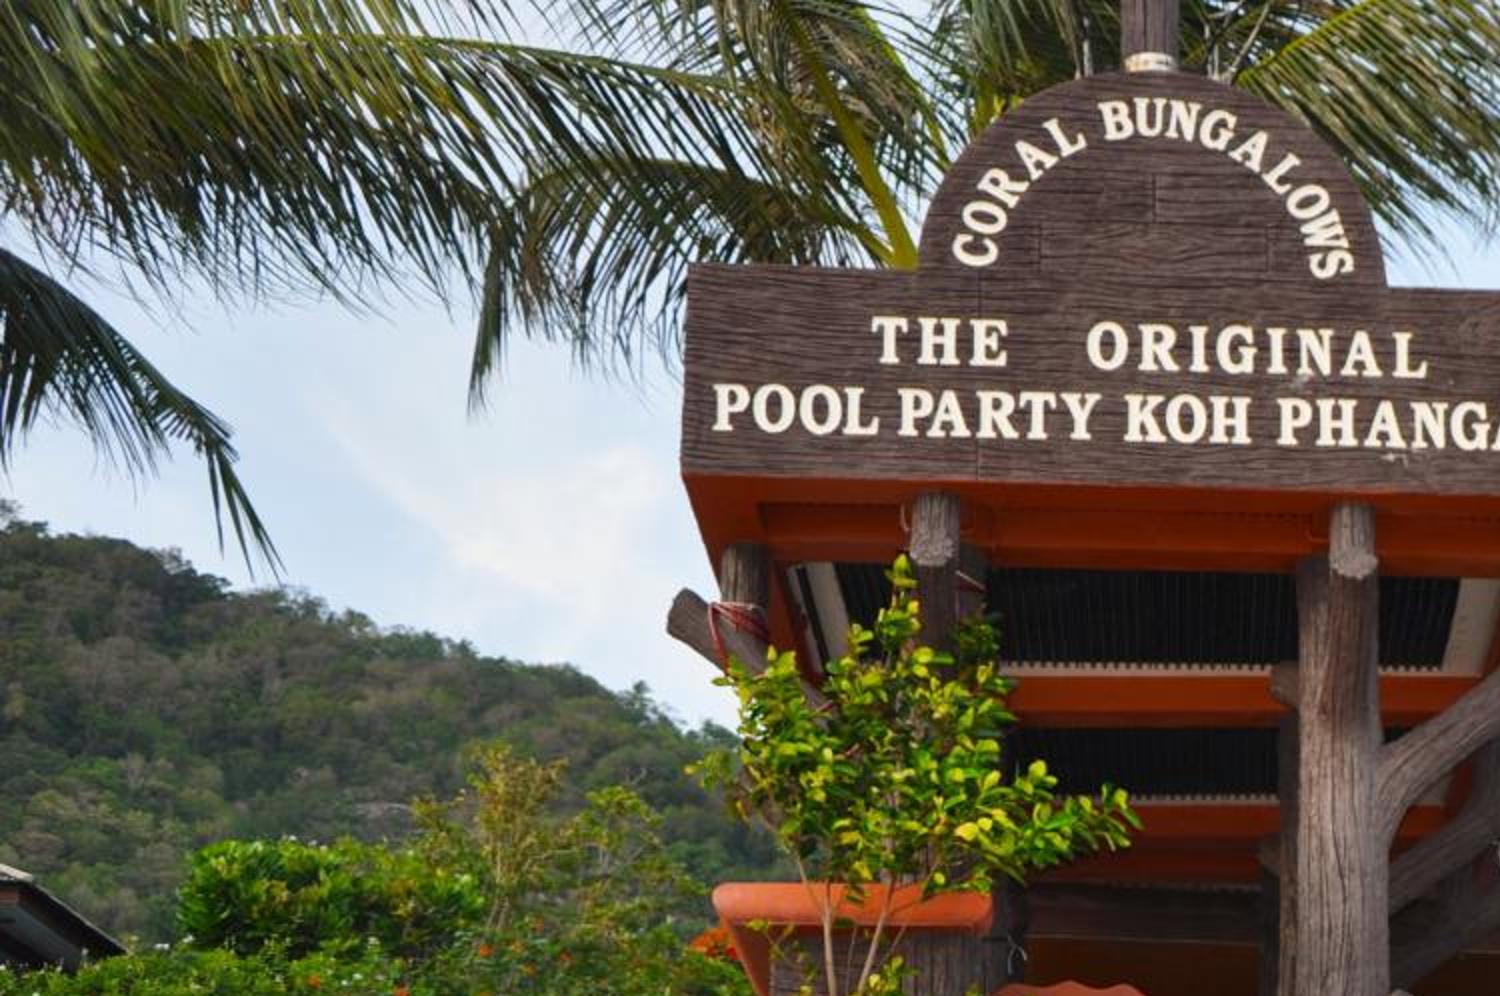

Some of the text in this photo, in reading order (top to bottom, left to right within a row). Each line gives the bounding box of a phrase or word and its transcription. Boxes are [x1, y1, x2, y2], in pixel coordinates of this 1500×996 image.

[953, 98, 1354, 279] CORAL BUNGALOWS
[872, 317, 1427, 381] THE ORIGINAL
[713, 384, 879, 435] POOL
[898, 388, 1101, 440] PARTY
[1124, 394, 1251, 444] KOH
